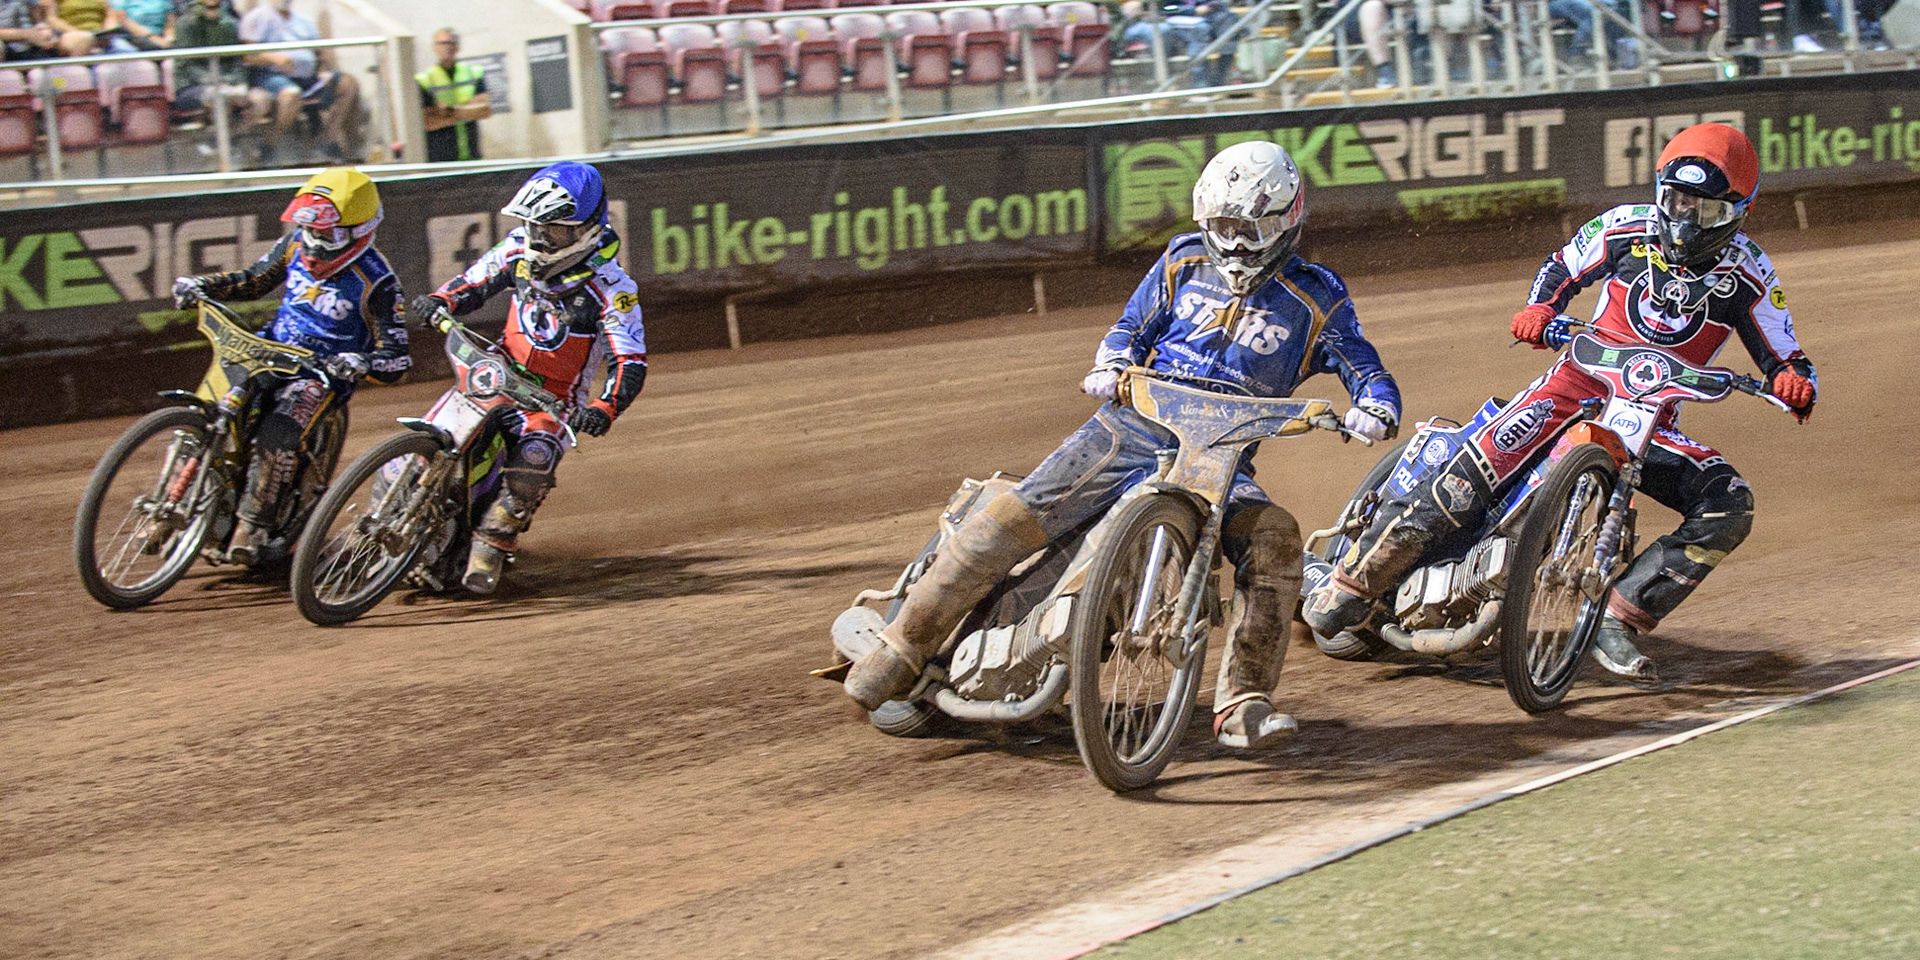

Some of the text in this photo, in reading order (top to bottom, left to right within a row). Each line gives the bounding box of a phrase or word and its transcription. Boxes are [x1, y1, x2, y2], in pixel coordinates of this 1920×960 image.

[1216, 108, 1566, 188] KERIGHT
[650, 184, 1087, 275] bike-right.com
[1175, 291, 1291, 356] STARS
[1613, 417, 1638, 431] ATPI
